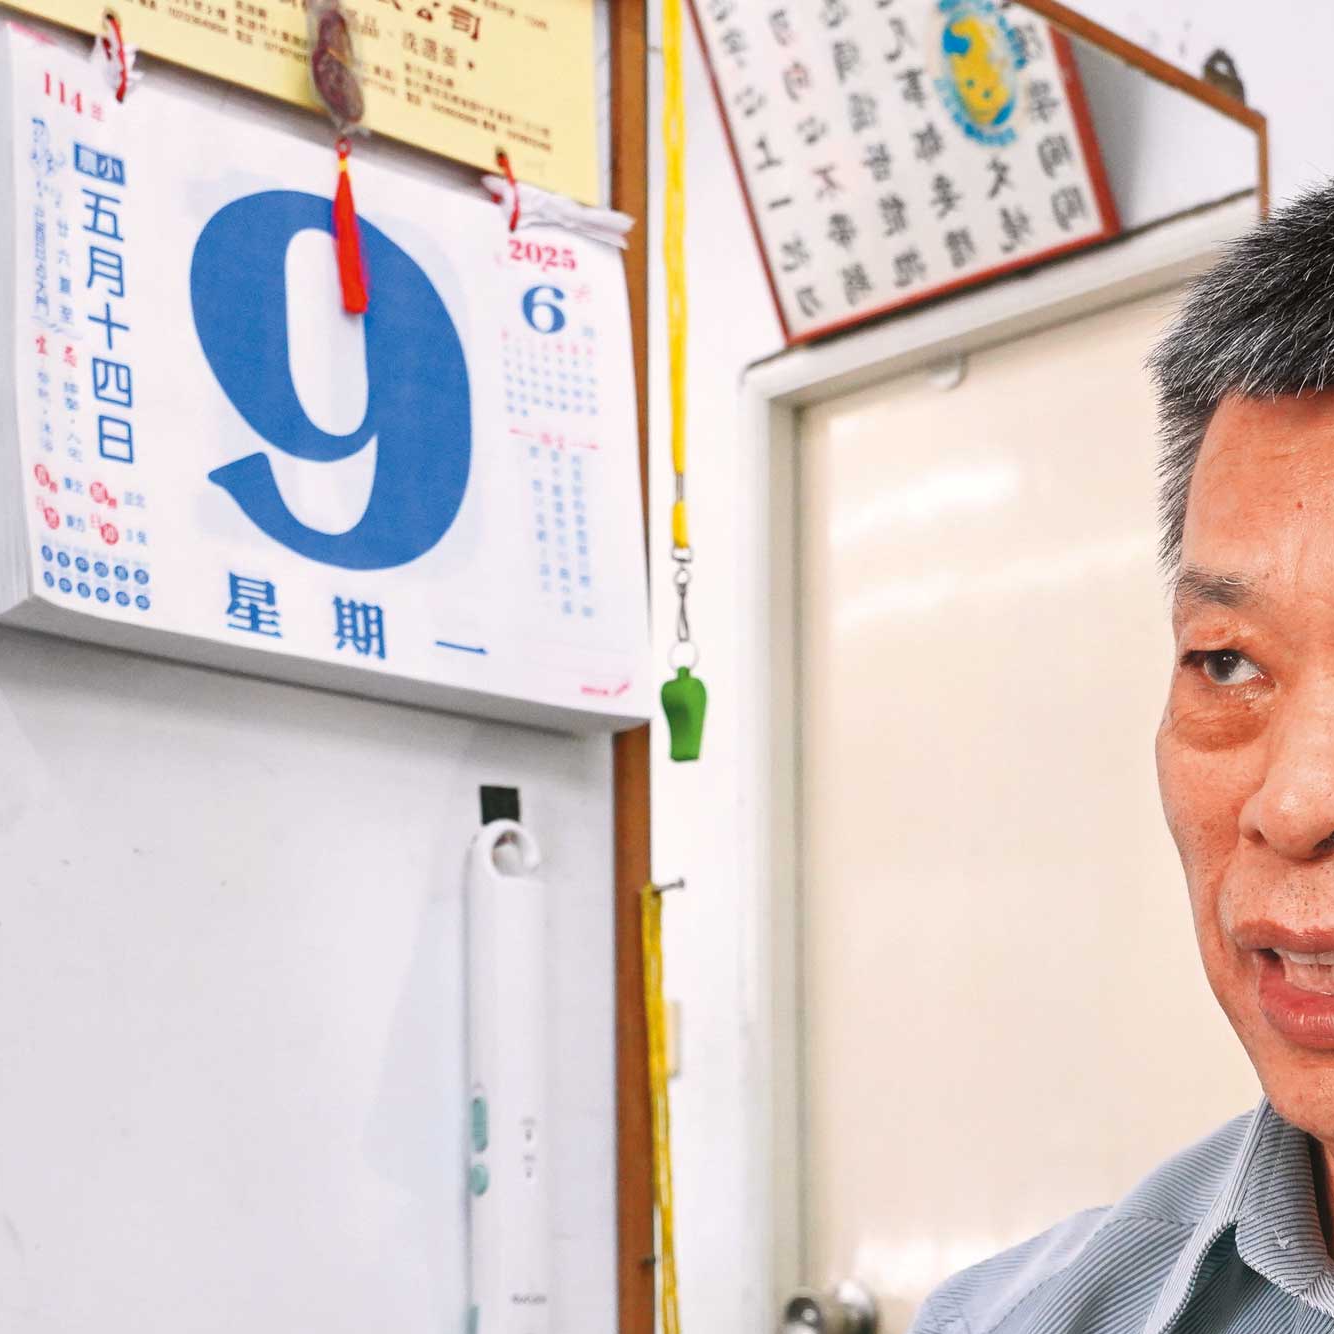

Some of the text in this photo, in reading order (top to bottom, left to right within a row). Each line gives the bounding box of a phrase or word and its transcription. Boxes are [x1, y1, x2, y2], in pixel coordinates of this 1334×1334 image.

[507, 239, 579, 271] 2025
[81, 187, 134, 464] 五月十四日
[521, 284, 566, 334] 6
[190, 190, 472, 571] 9
[225, 571, 489, 660] 星期一
